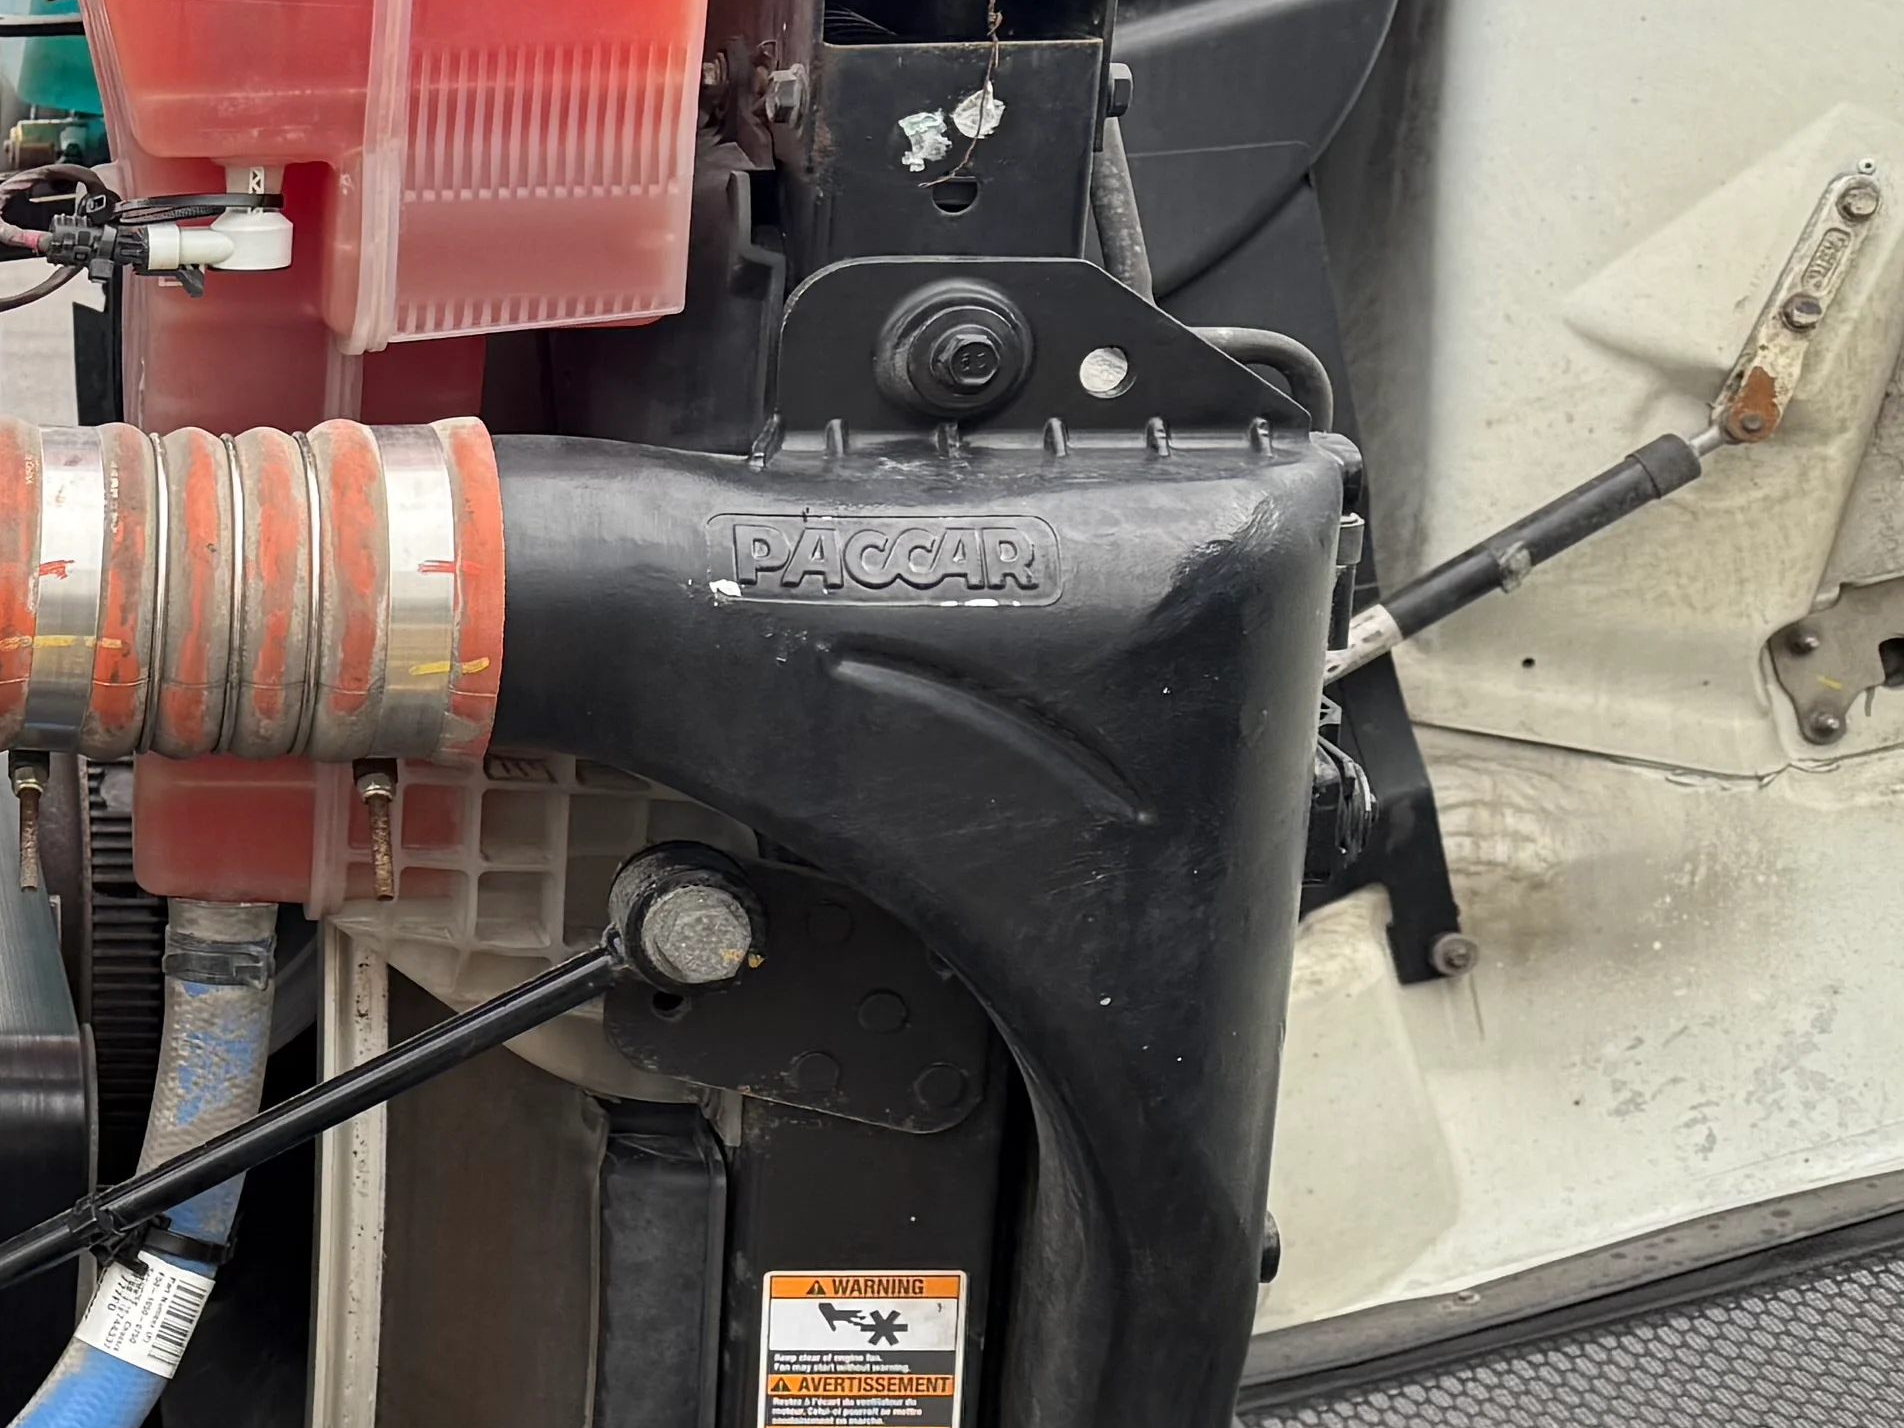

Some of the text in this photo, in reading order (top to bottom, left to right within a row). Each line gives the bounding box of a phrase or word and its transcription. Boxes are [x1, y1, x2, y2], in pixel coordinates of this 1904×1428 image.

[732, 523, 1040, 591] PACCAR
[832, 1278, 925, 1295] WARNING
[797, 1376, 950, 1393] AVERTISSEMENT
